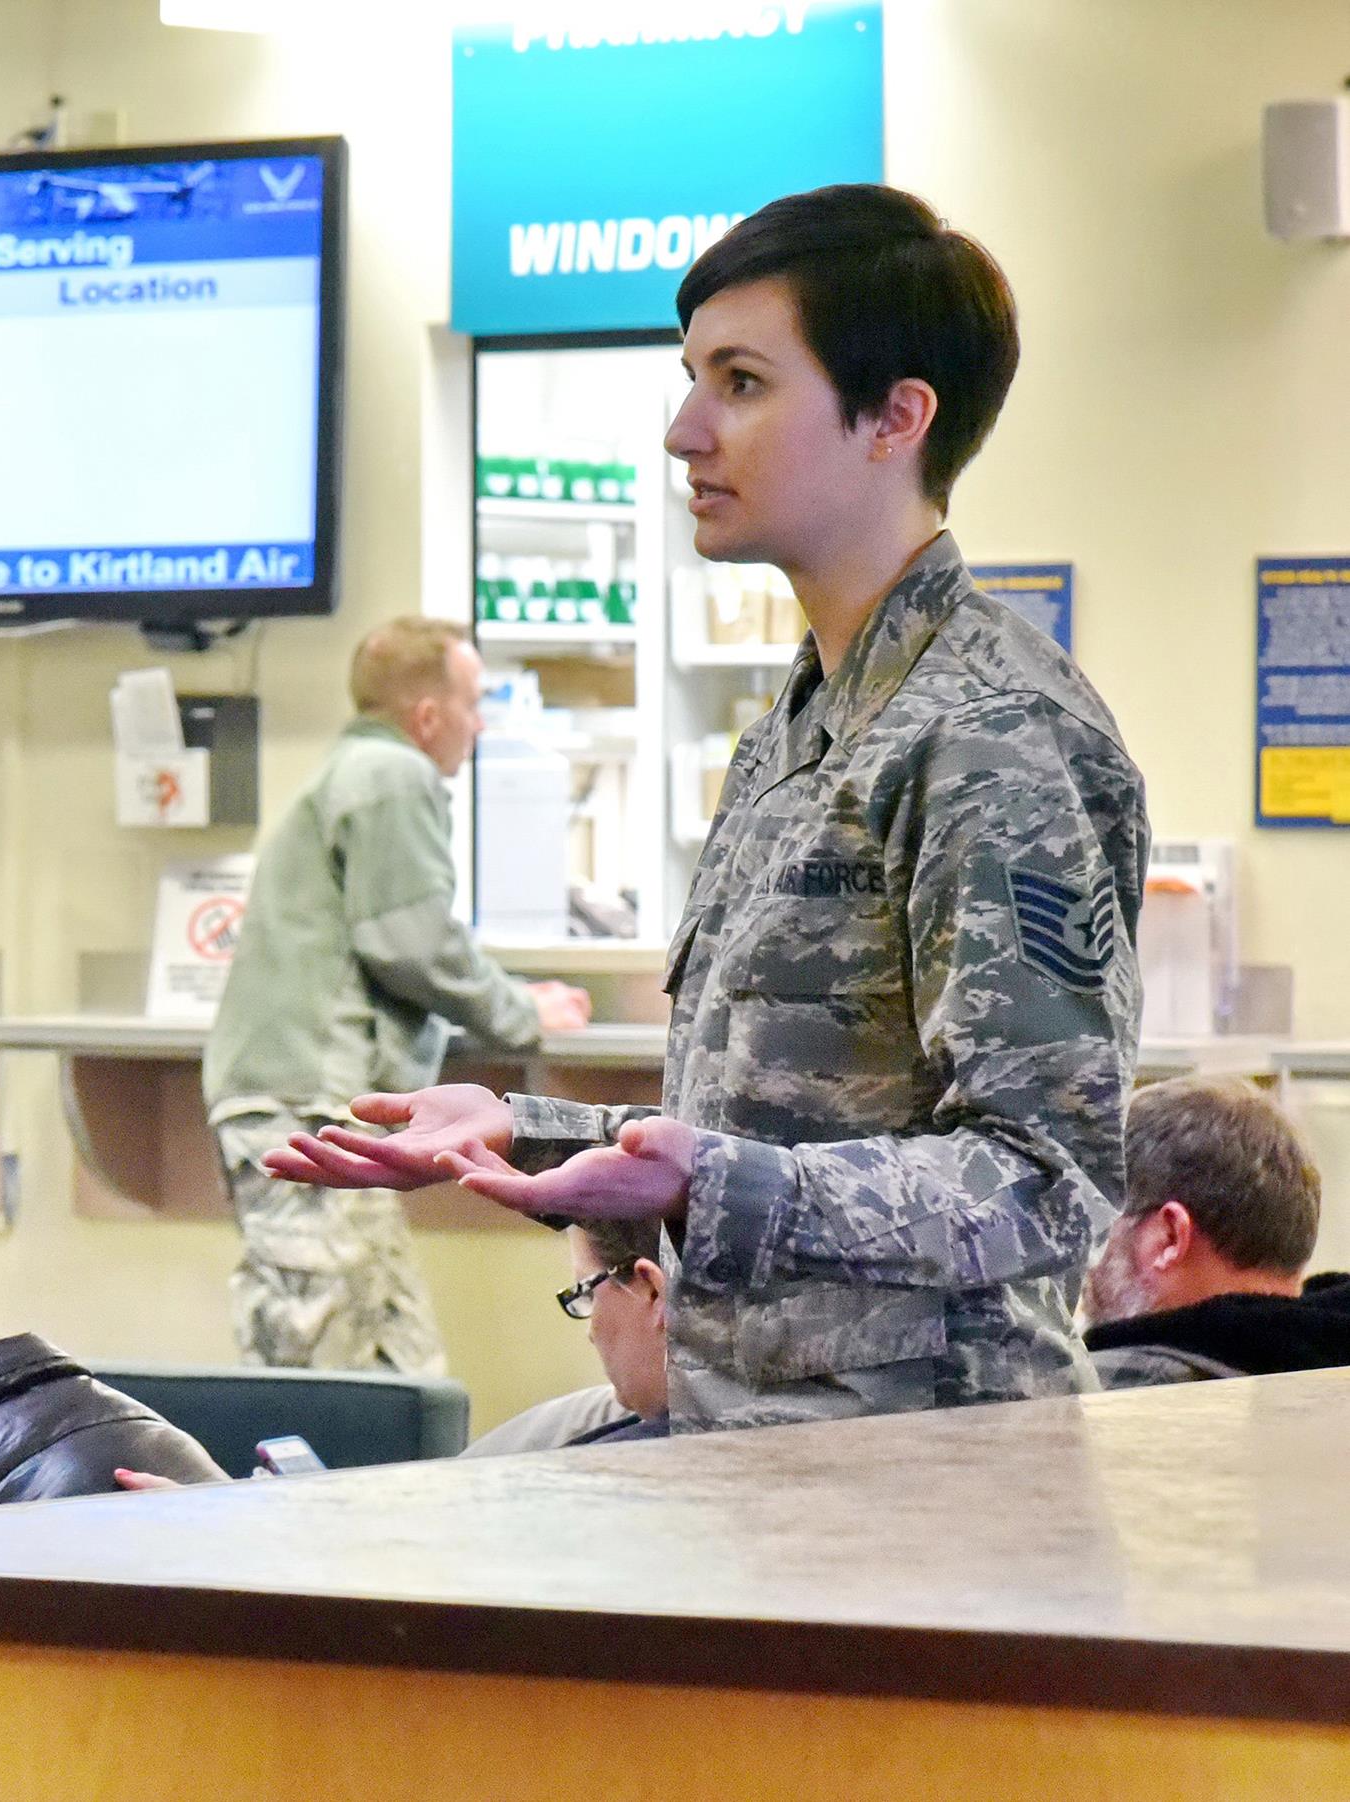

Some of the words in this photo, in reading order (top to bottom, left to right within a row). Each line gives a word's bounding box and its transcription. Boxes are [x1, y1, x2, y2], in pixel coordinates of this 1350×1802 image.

[58, 276, 219, 307] Location
[17, 555, 62, 588] to
[68, 547, 229, 587] Kirtland
[238, 547, 300, 581] Air
[804, 861, 887, 894] FORCE
